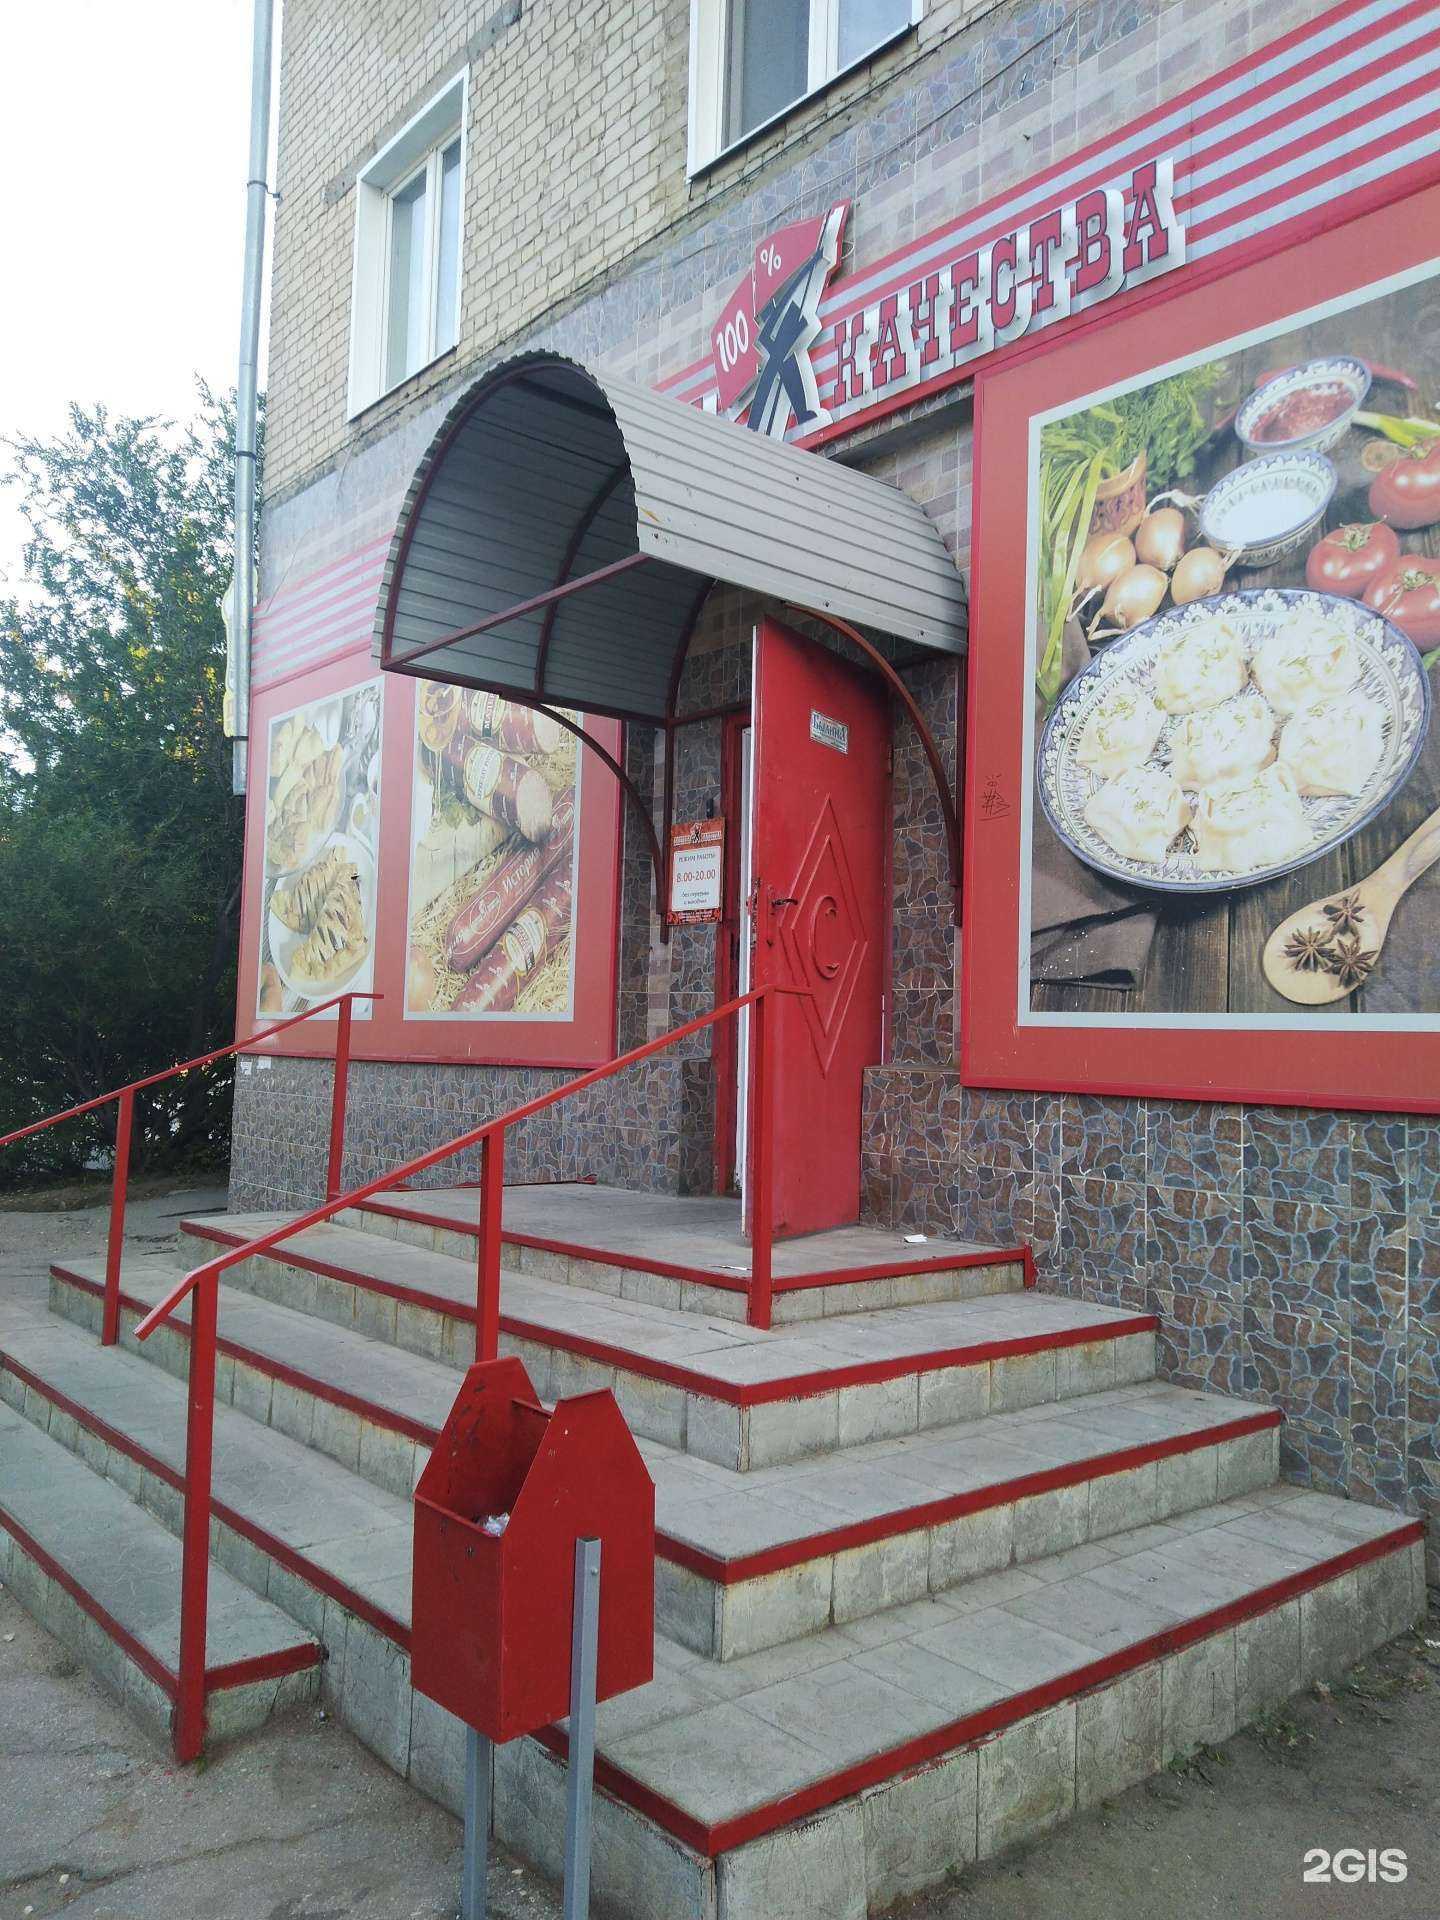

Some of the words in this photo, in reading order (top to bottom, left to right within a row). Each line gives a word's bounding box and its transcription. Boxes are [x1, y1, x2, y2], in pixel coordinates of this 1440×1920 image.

[717, 309, 749, 373] 100
[760, 244, 782, 276] %
[833, 159, 1180, 408] КАЧЕСТВА
[676, 868, 716, 883] 8.00-20.00
